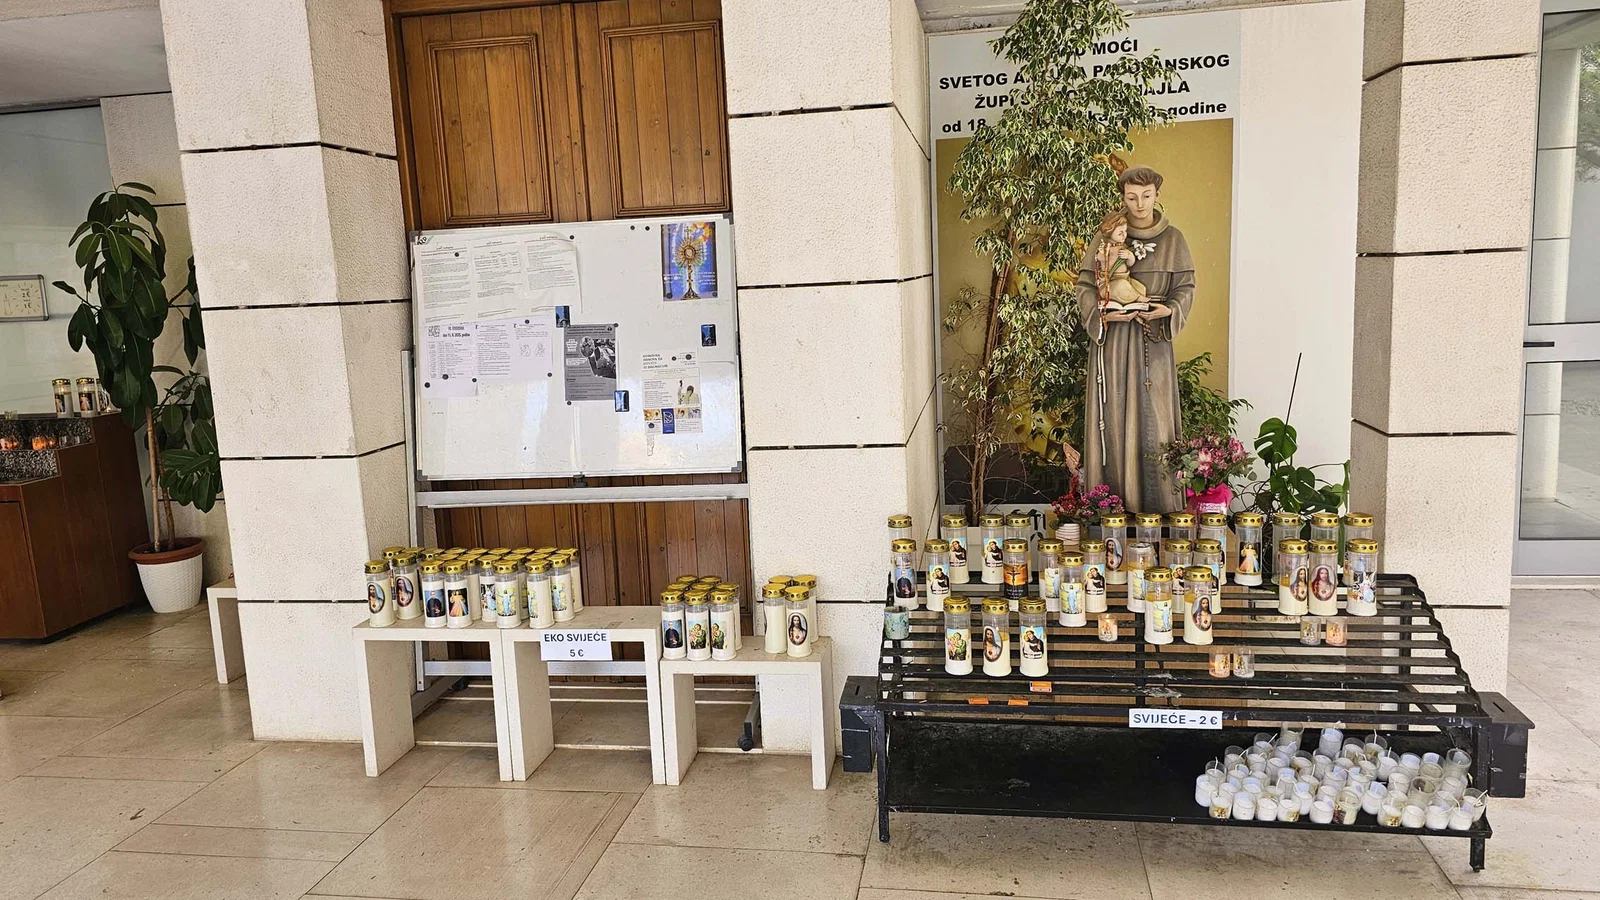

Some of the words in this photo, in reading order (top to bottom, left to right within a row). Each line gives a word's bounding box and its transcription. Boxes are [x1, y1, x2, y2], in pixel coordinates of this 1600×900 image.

[1092, 37, 1138, 56] MOĆI
[939, 72, 1008, 90] SVETOG
[942, 121, 962, 133] od
[544, 633, 564, 642] EKO
[566, 631, 607, 642] SVIJEĆE
[570, 649, 576, 657] 5
[578, 649, 584, 657] €
[1133, 712, 1186, 724] SVIJEĆE
[1199, 715, 1207, 725] 2
[1210, 716, 1218, 725] €
